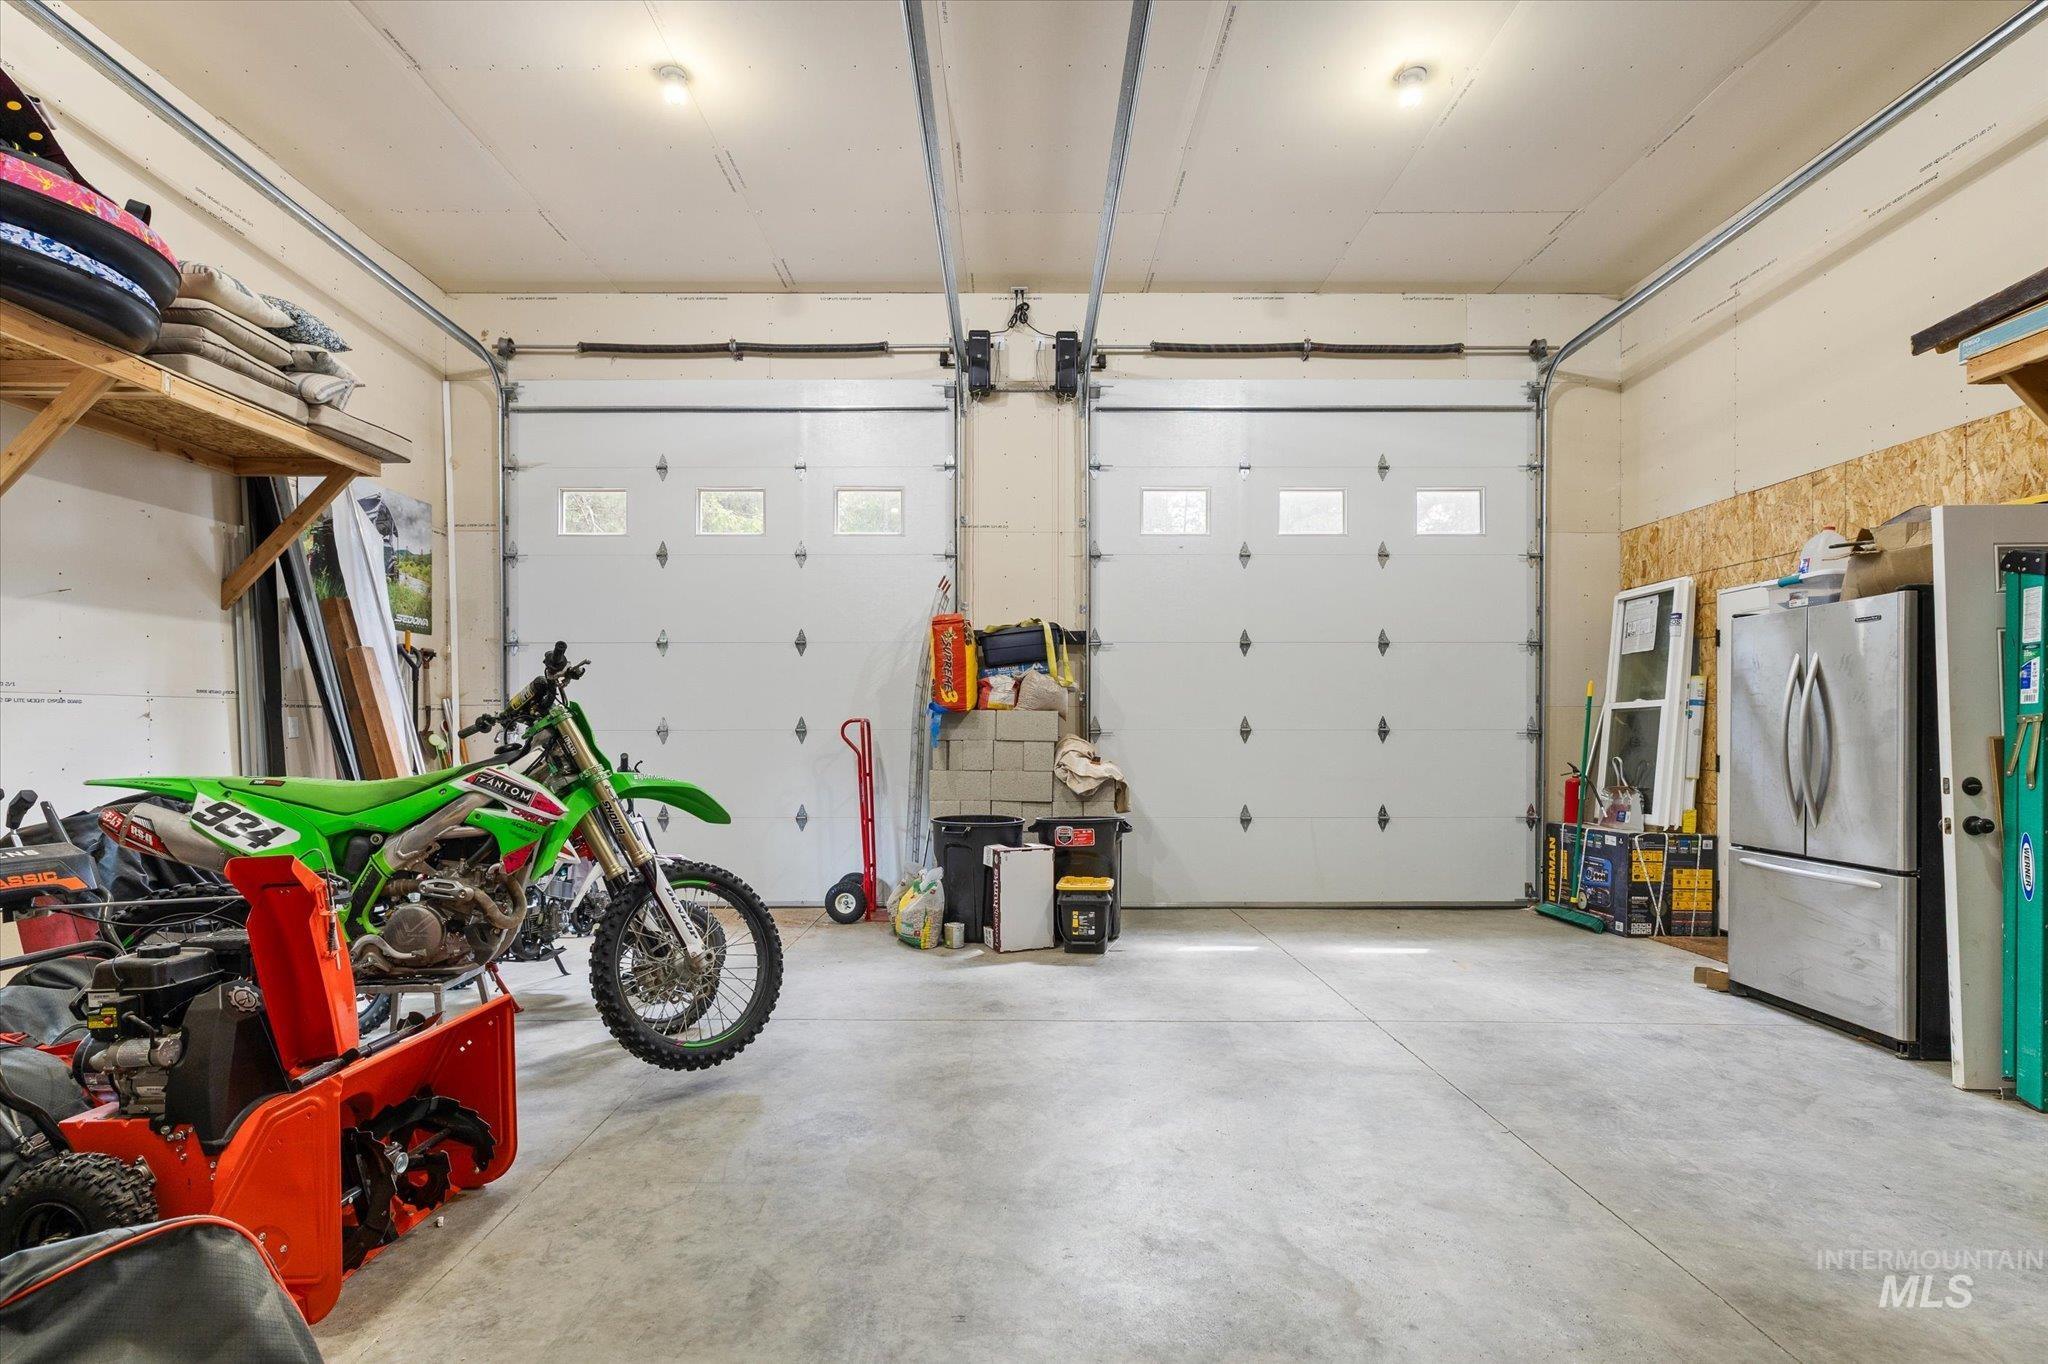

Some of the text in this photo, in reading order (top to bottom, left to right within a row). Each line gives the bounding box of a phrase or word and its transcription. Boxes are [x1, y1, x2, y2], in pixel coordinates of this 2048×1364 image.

[394, 613, 429, 627] SEDONA
[941, 635, 954, 691] SUPREME
[192, 801, 286, 850] 934
[603, 801, 626, 836] SHOWA
[1548, 837, 1556, 901] FIRMAN
[2024, 847, 2032, 887] WERNER
[665, 887, 698, 940] DUNLOP
